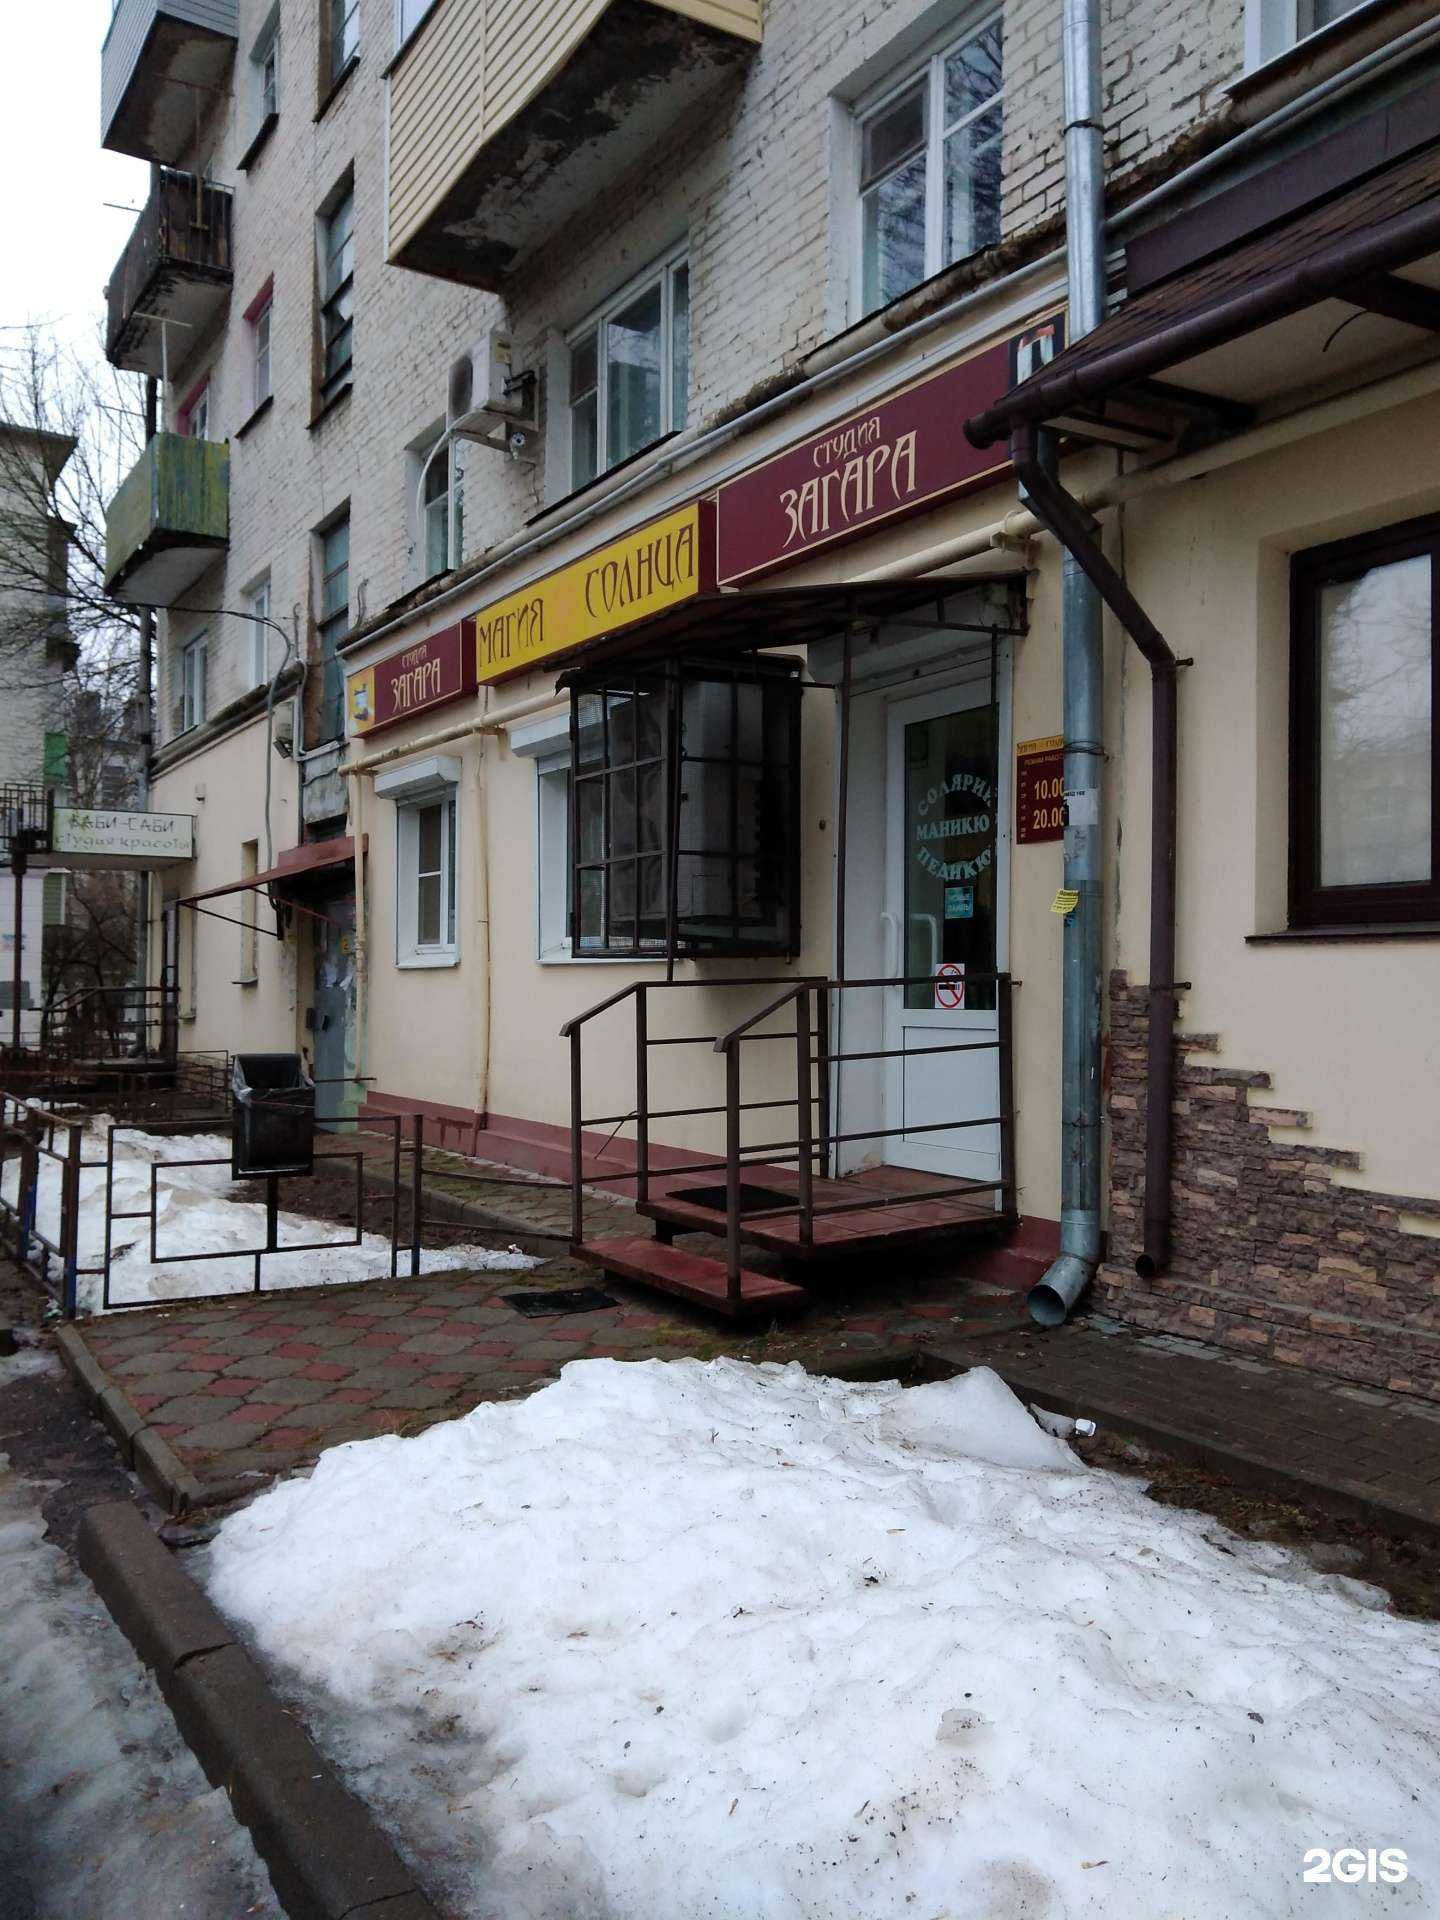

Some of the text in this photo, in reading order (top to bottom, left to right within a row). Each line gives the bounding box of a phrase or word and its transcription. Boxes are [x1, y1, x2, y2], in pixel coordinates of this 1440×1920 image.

[813, 417, 880, 467] СТУДИЯ
[780, 430, 917, 549] ЗАГАРА
[480, 523, 695, 667] МАГИЯ СОЛНЦА
[391, 658, 441, 713] ЗАГАРА
